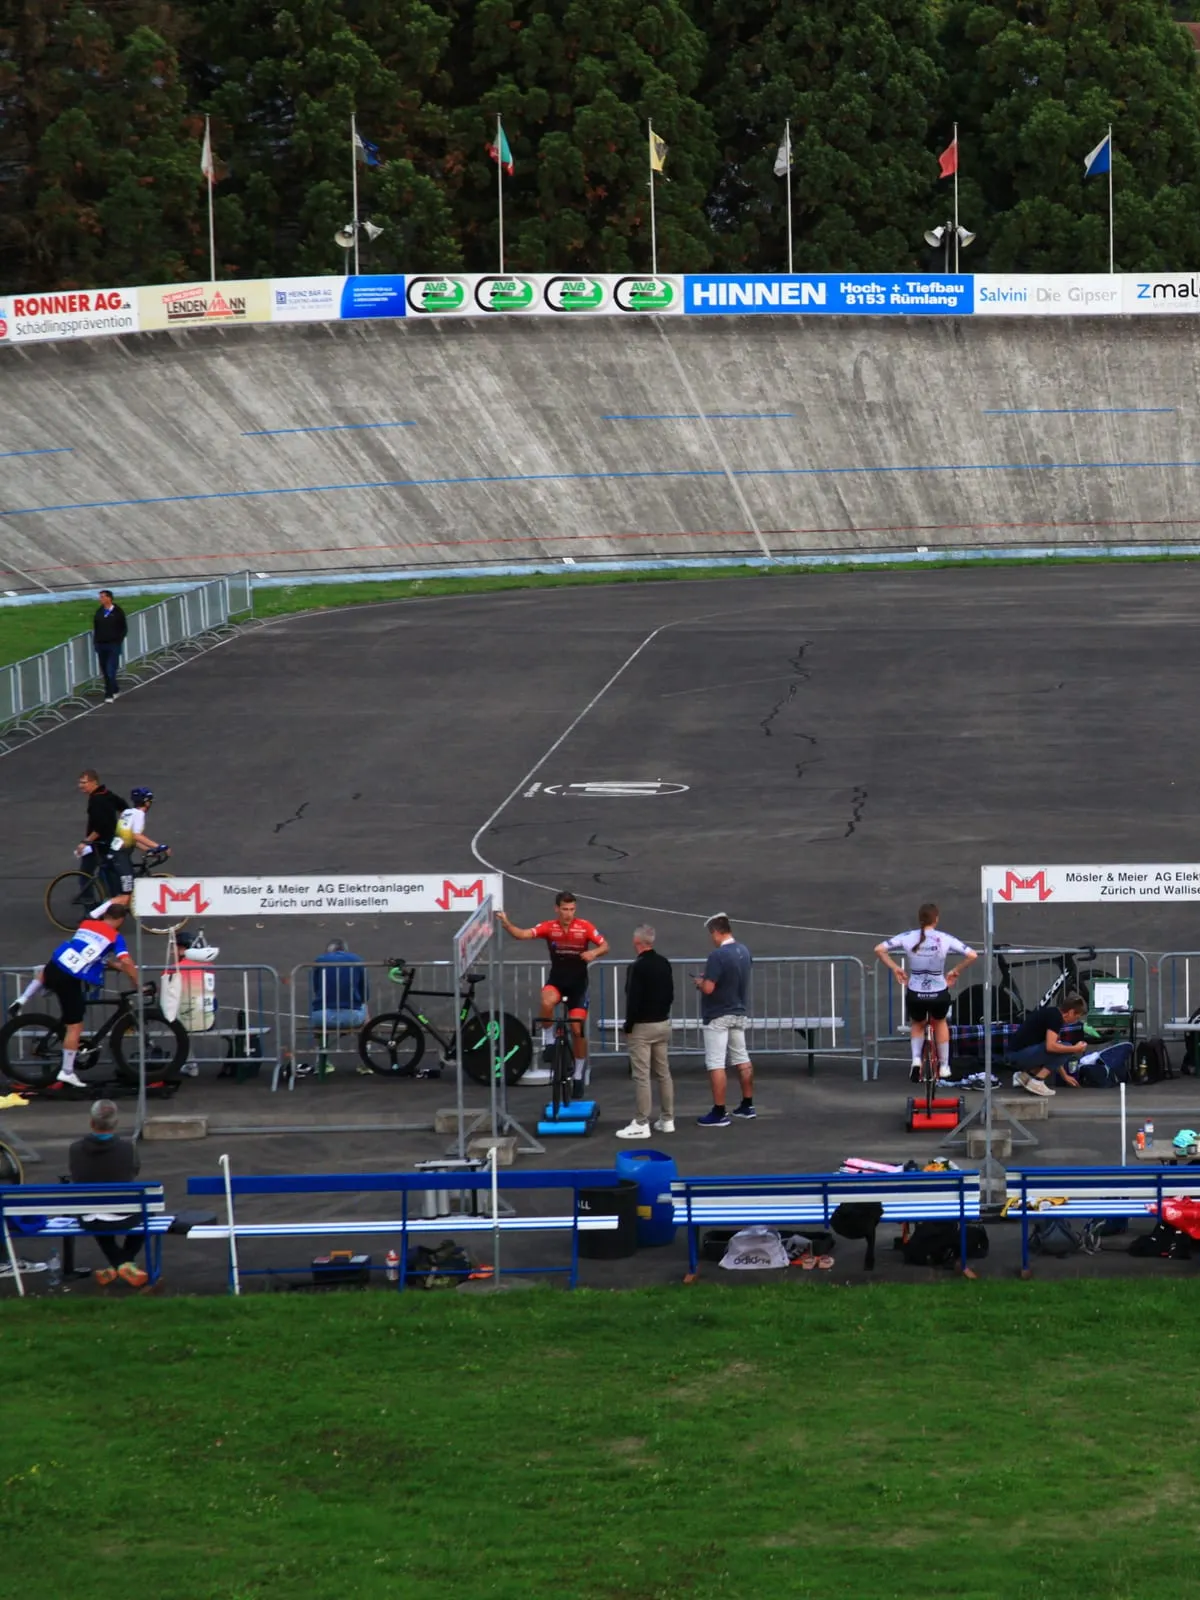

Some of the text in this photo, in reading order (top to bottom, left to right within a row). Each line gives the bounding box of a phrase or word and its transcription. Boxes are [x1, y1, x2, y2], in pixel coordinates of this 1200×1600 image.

[423, 282, 448, 292] AVB
[491, 281, 517, 291] AVB
[561, 281, 587, 291] AVB
[631, 280, 656, 291] AVB
[840, 282, 964, 294] Hoch- + Tiefbau
[693, 282, 827, 306] HINNEN
[845, 293, 958, 307] 8153 Rümlang
[979, 287, 1118, 305] Salvini Die Gipser
[14, 295, 90, 317] RONNER
[16, 317, 133, 337] Schädlingsprävention
[1066, 872, 1103, 883] Mösler
[1106, 872, 1115, 882] &
[1118, 872, 1148, 882] Meier
[1155, 872, 1172, 882] AG
[223, 884, 263, 895] Mösler
[266, 884, 275, 895] &
[278, 884, 311, 895] Meier
[316, 883, 335, 894] AG
[338, 882, 425, 895] Elektroanlagen
[1100, 884, 1136, 896] Zürich
[1139, 885, 1161, 895] und
[260, 896, 389, 909] Zürich und Wallisellen
